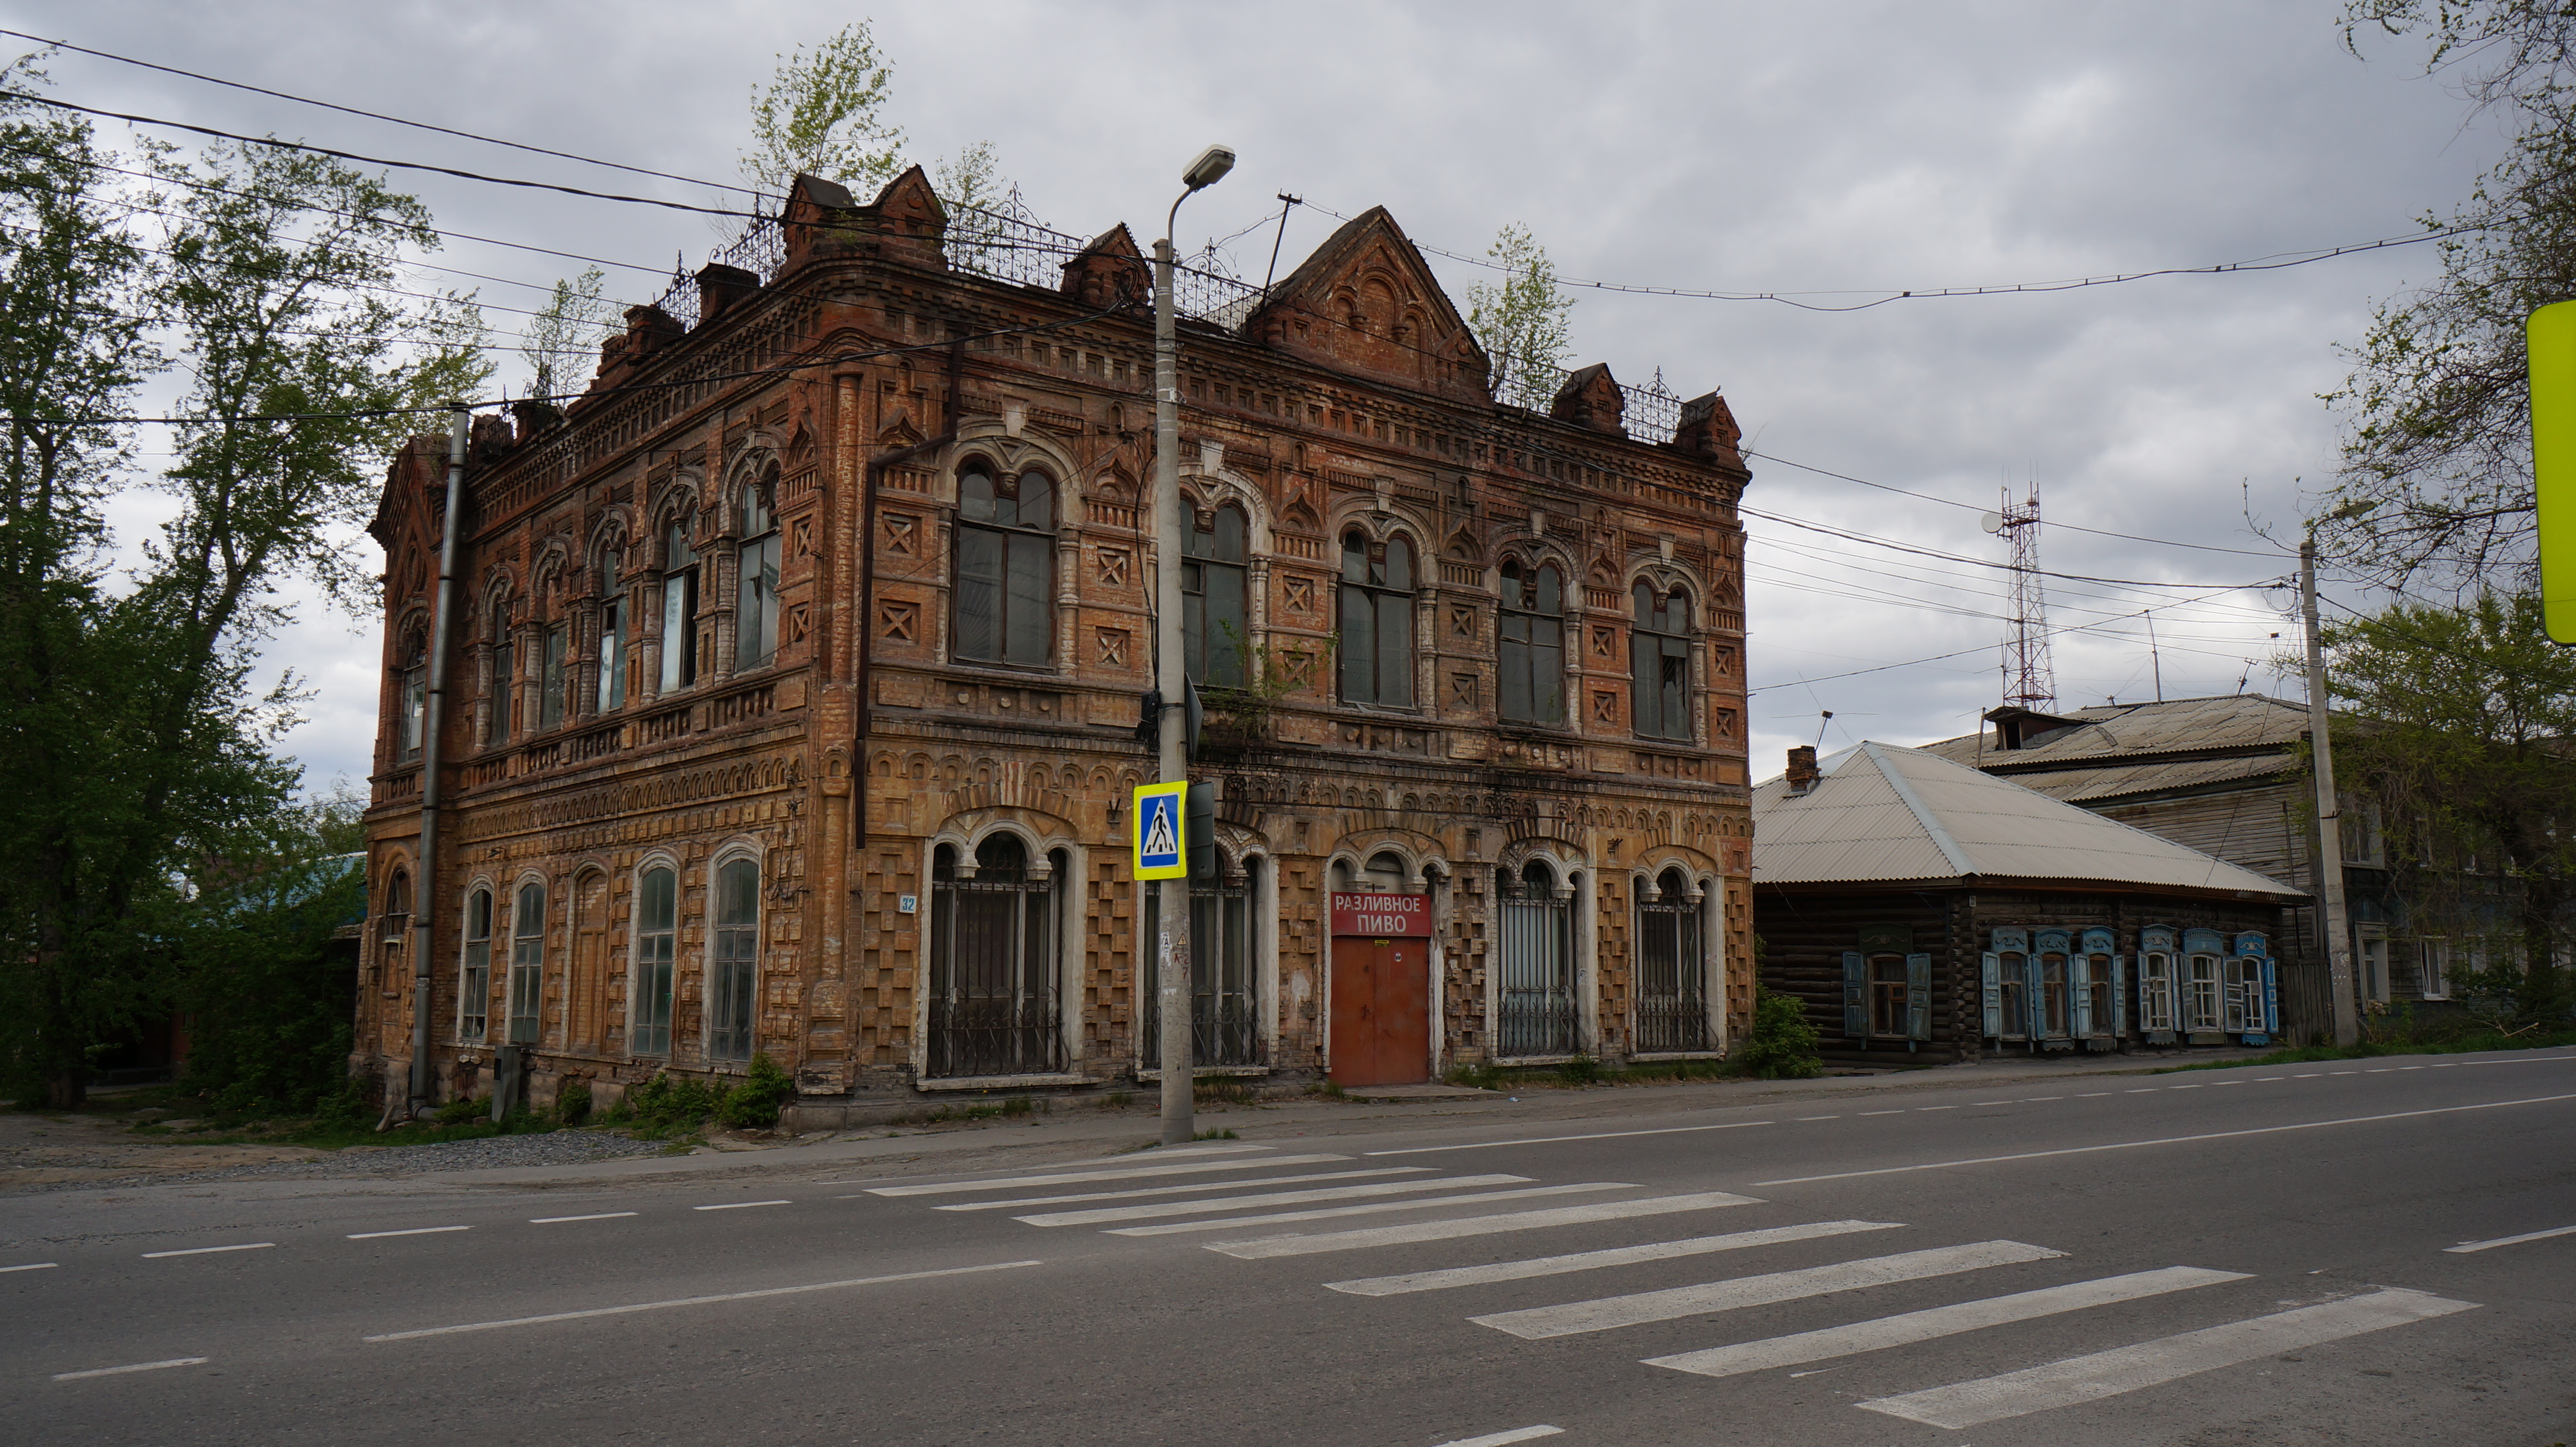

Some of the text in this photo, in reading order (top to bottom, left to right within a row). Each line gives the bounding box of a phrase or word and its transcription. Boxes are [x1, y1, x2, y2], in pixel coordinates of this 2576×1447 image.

[903, 898, 915, 911] 32
[1335, 895, 1420, 912] РАЗЛИВНОЕ
[1357, 914, 1407, 933] ПИВО
